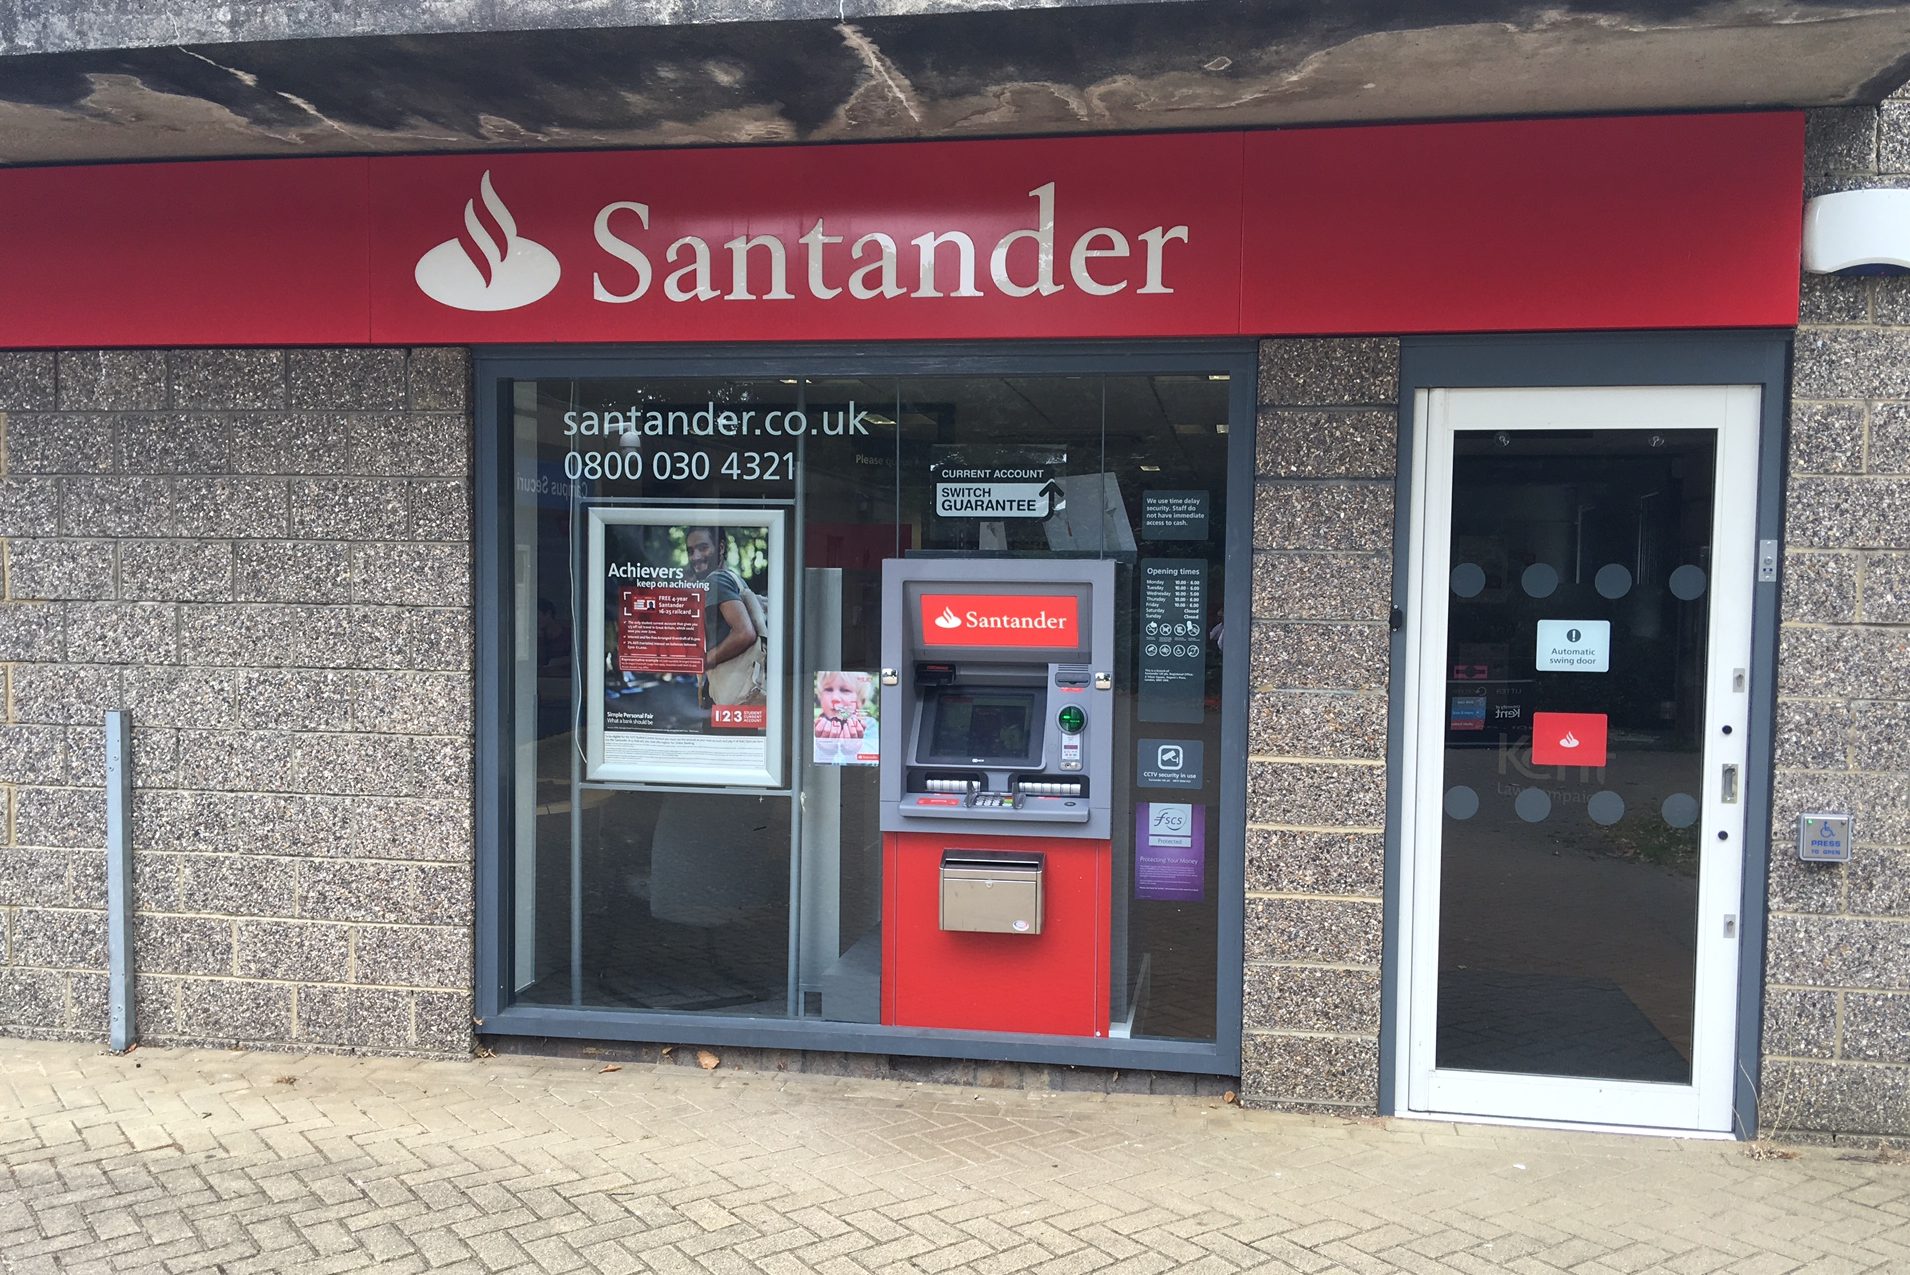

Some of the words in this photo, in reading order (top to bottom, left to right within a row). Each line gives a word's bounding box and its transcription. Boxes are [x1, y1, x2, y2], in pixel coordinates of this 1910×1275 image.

[592, 181, 1189, 304] Santander
[563, 401, 869, 436] santander.co.uk
[564, 451, 643, 481] 0800
[653, 451, 710, 481] 030
[720, 452, 794, 481] 4321
[942, 470, 991, 478] CURRENT
[994, 470, 1044, 478] ACCOUNT
[942, 487, 991, 498] SWITCH
[941, 499, 1037, 511] GUARANTEE
[608, 562, 684, 579] Achievers
[1147, 568, 1178, 576] Opening
[637, 579, 655, 589] keep
[669, 580, 710, 591] achieving
[966, 610, 1067, 629] Santander
[1551, 648, 1596, 656] Automatic
[1550, 657, 1574, 665] swing
[1157, 837, 1182, 845] Protected
[1140, 856, 1166, 864] Protecting
[1179, 857, 1198, 865] Money
